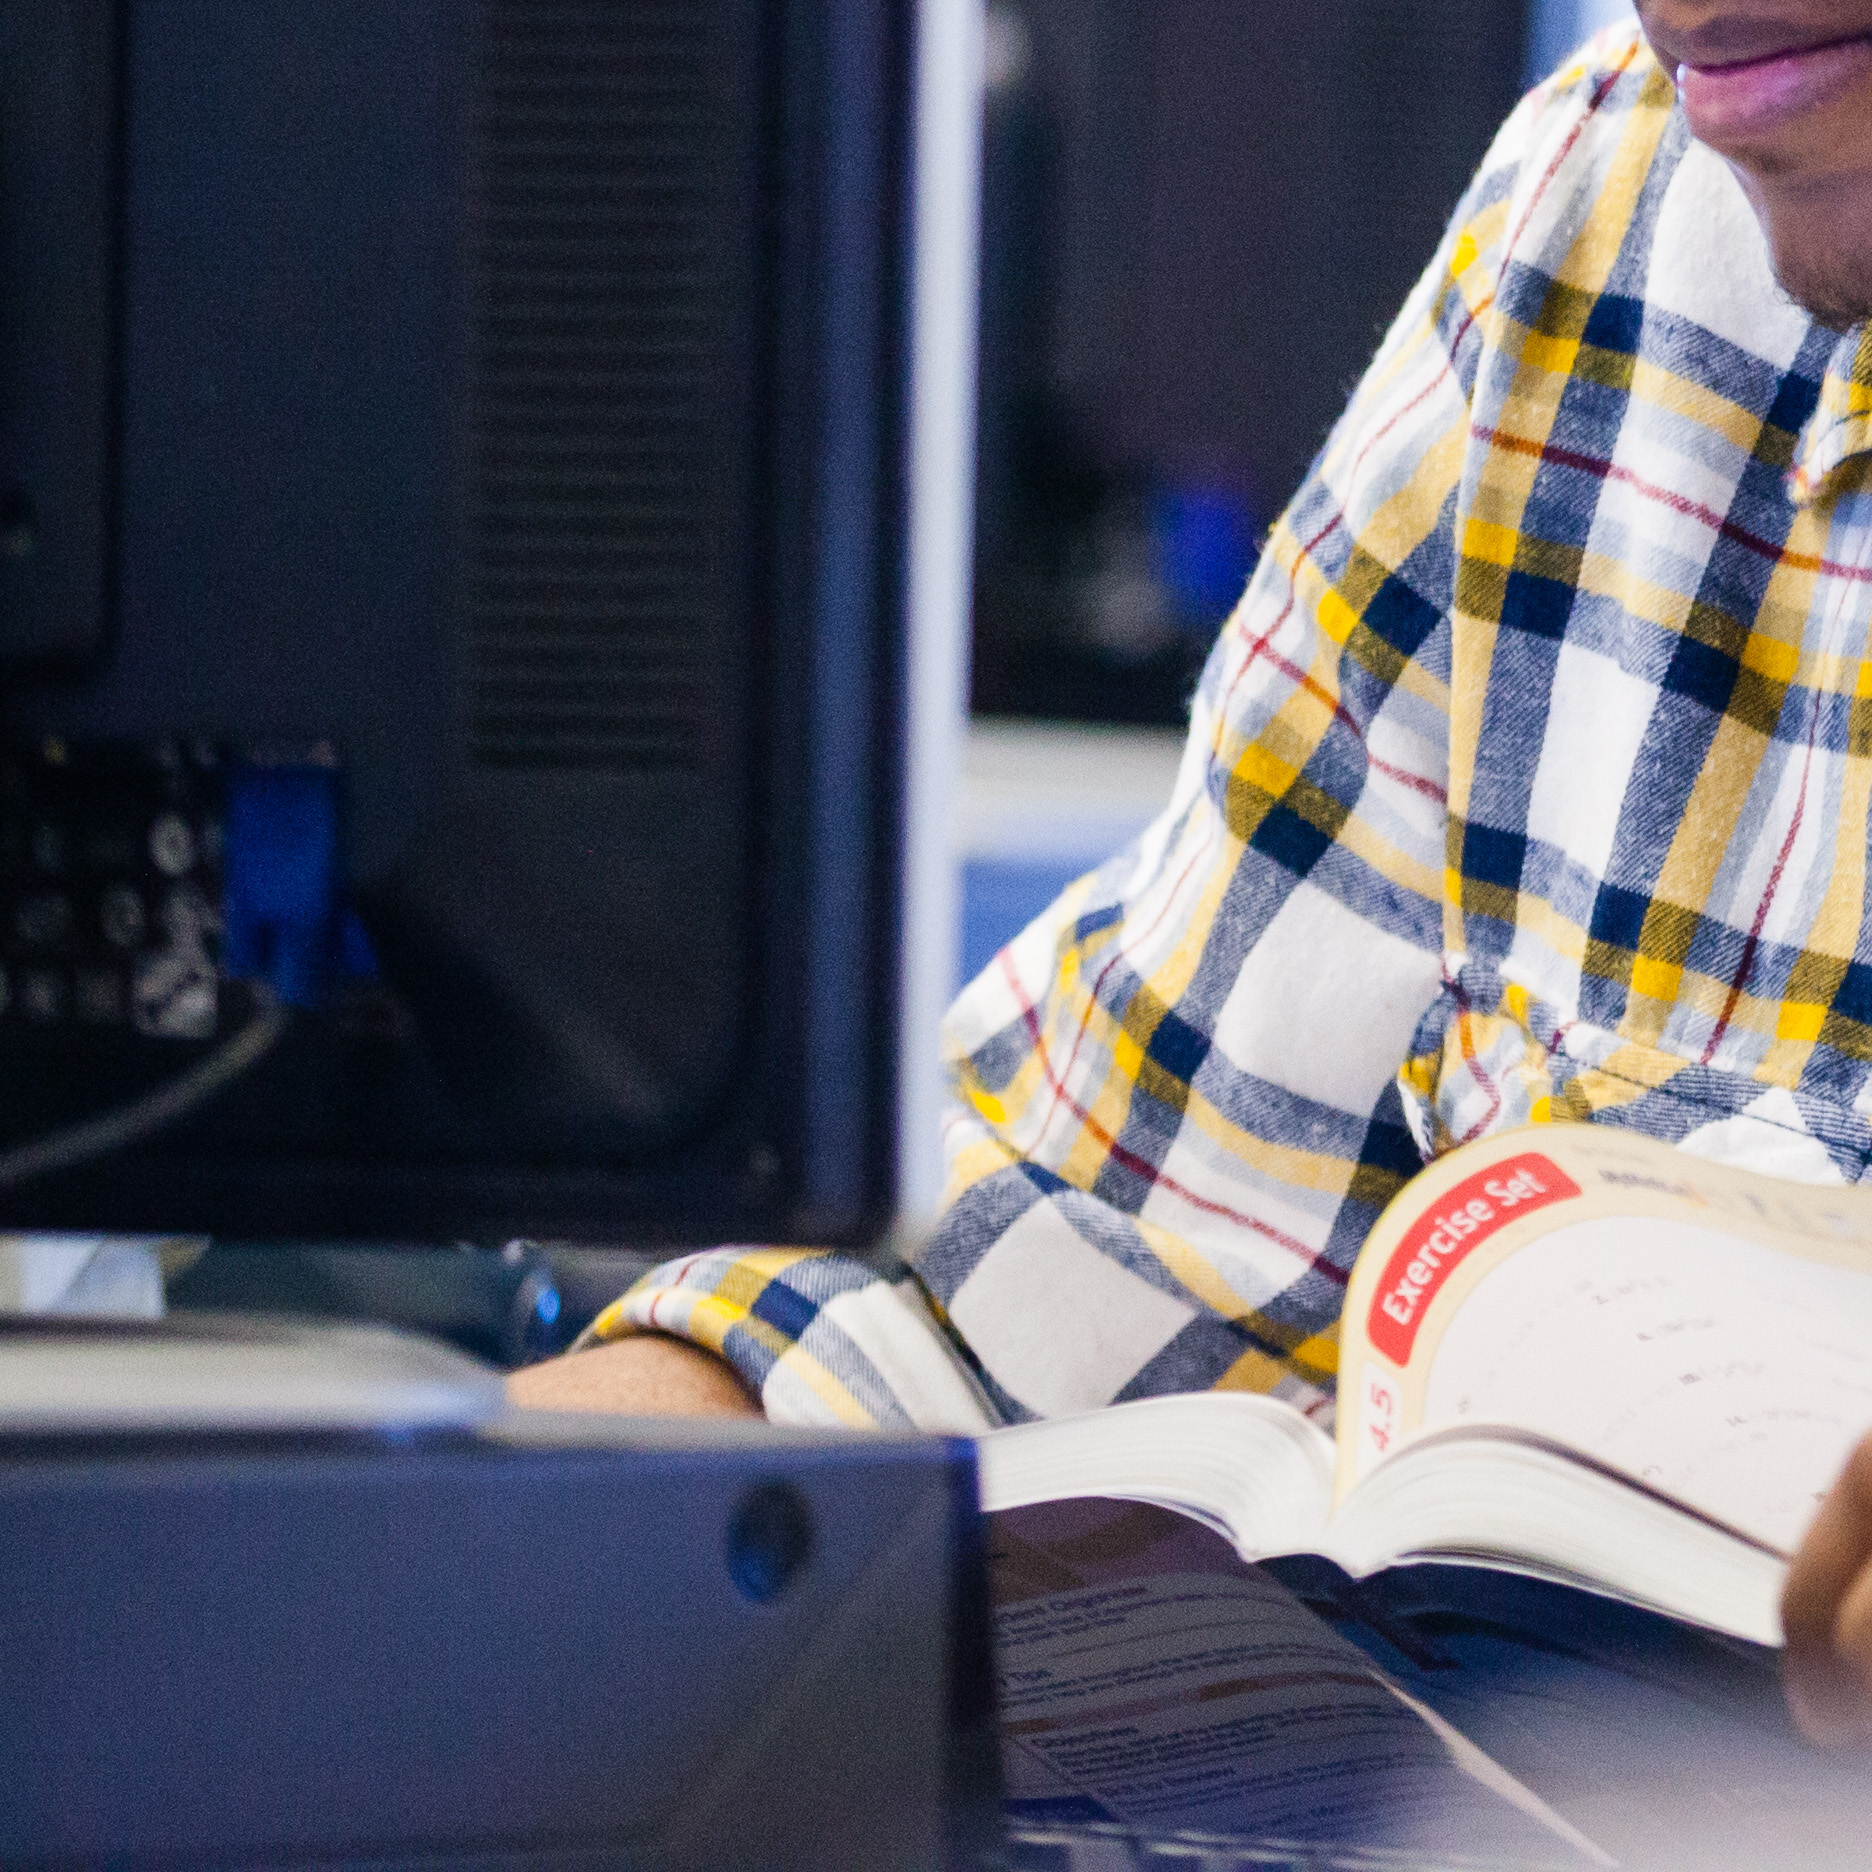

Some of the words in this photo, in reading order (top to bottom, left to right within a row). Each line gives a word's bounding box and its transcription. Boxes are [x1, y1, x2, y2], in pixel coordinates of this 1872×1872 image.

[1382, 1198, 1495, 1325] Exercise
[1483, 1168, 1547, 1207] Set
[1369, 1382, 1392, 1452] 4.5
